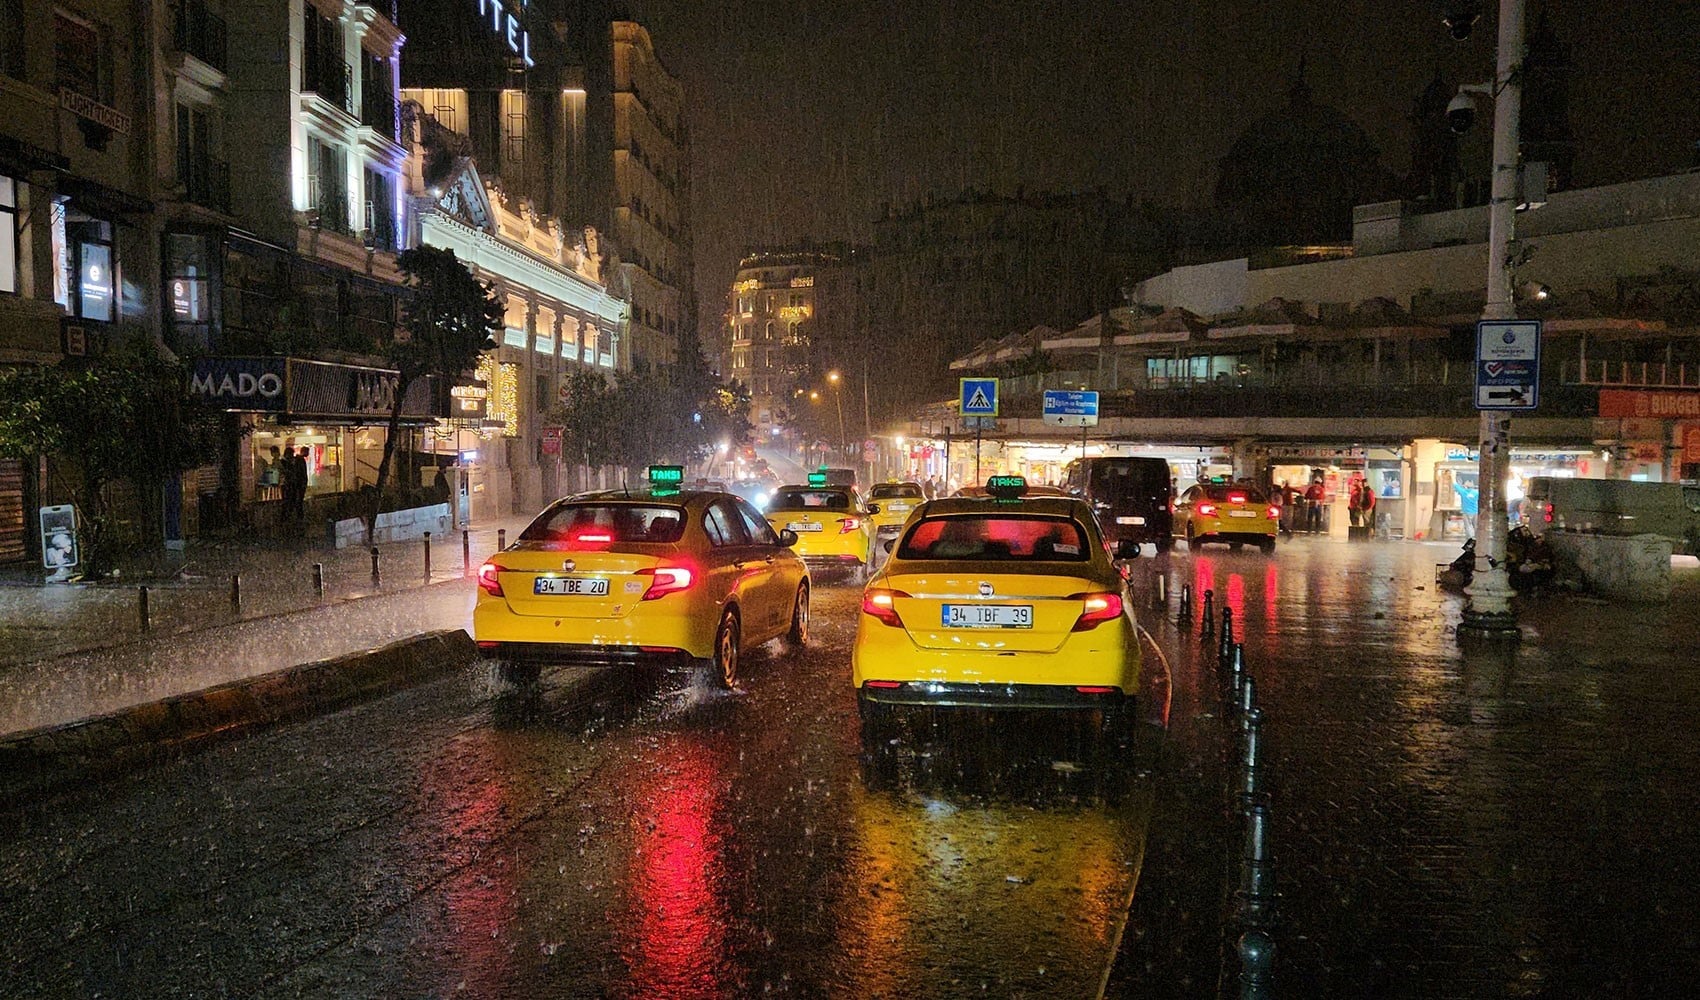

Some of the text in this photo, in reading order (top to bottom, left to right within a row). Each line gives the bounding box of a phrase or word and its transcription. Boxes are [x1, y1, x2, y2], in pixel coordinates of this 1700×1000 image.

[190, 372, 282, 397] MADO
[1652, 394, 1700, 415] BURGER
[651, 470, 681, 480] TAKSI
[991, 477, 1024, 486] TAKSI
[542, 580, 605, 593] 34 TBE 20
[951, 608, 1028, 622] 34 TBF 39
